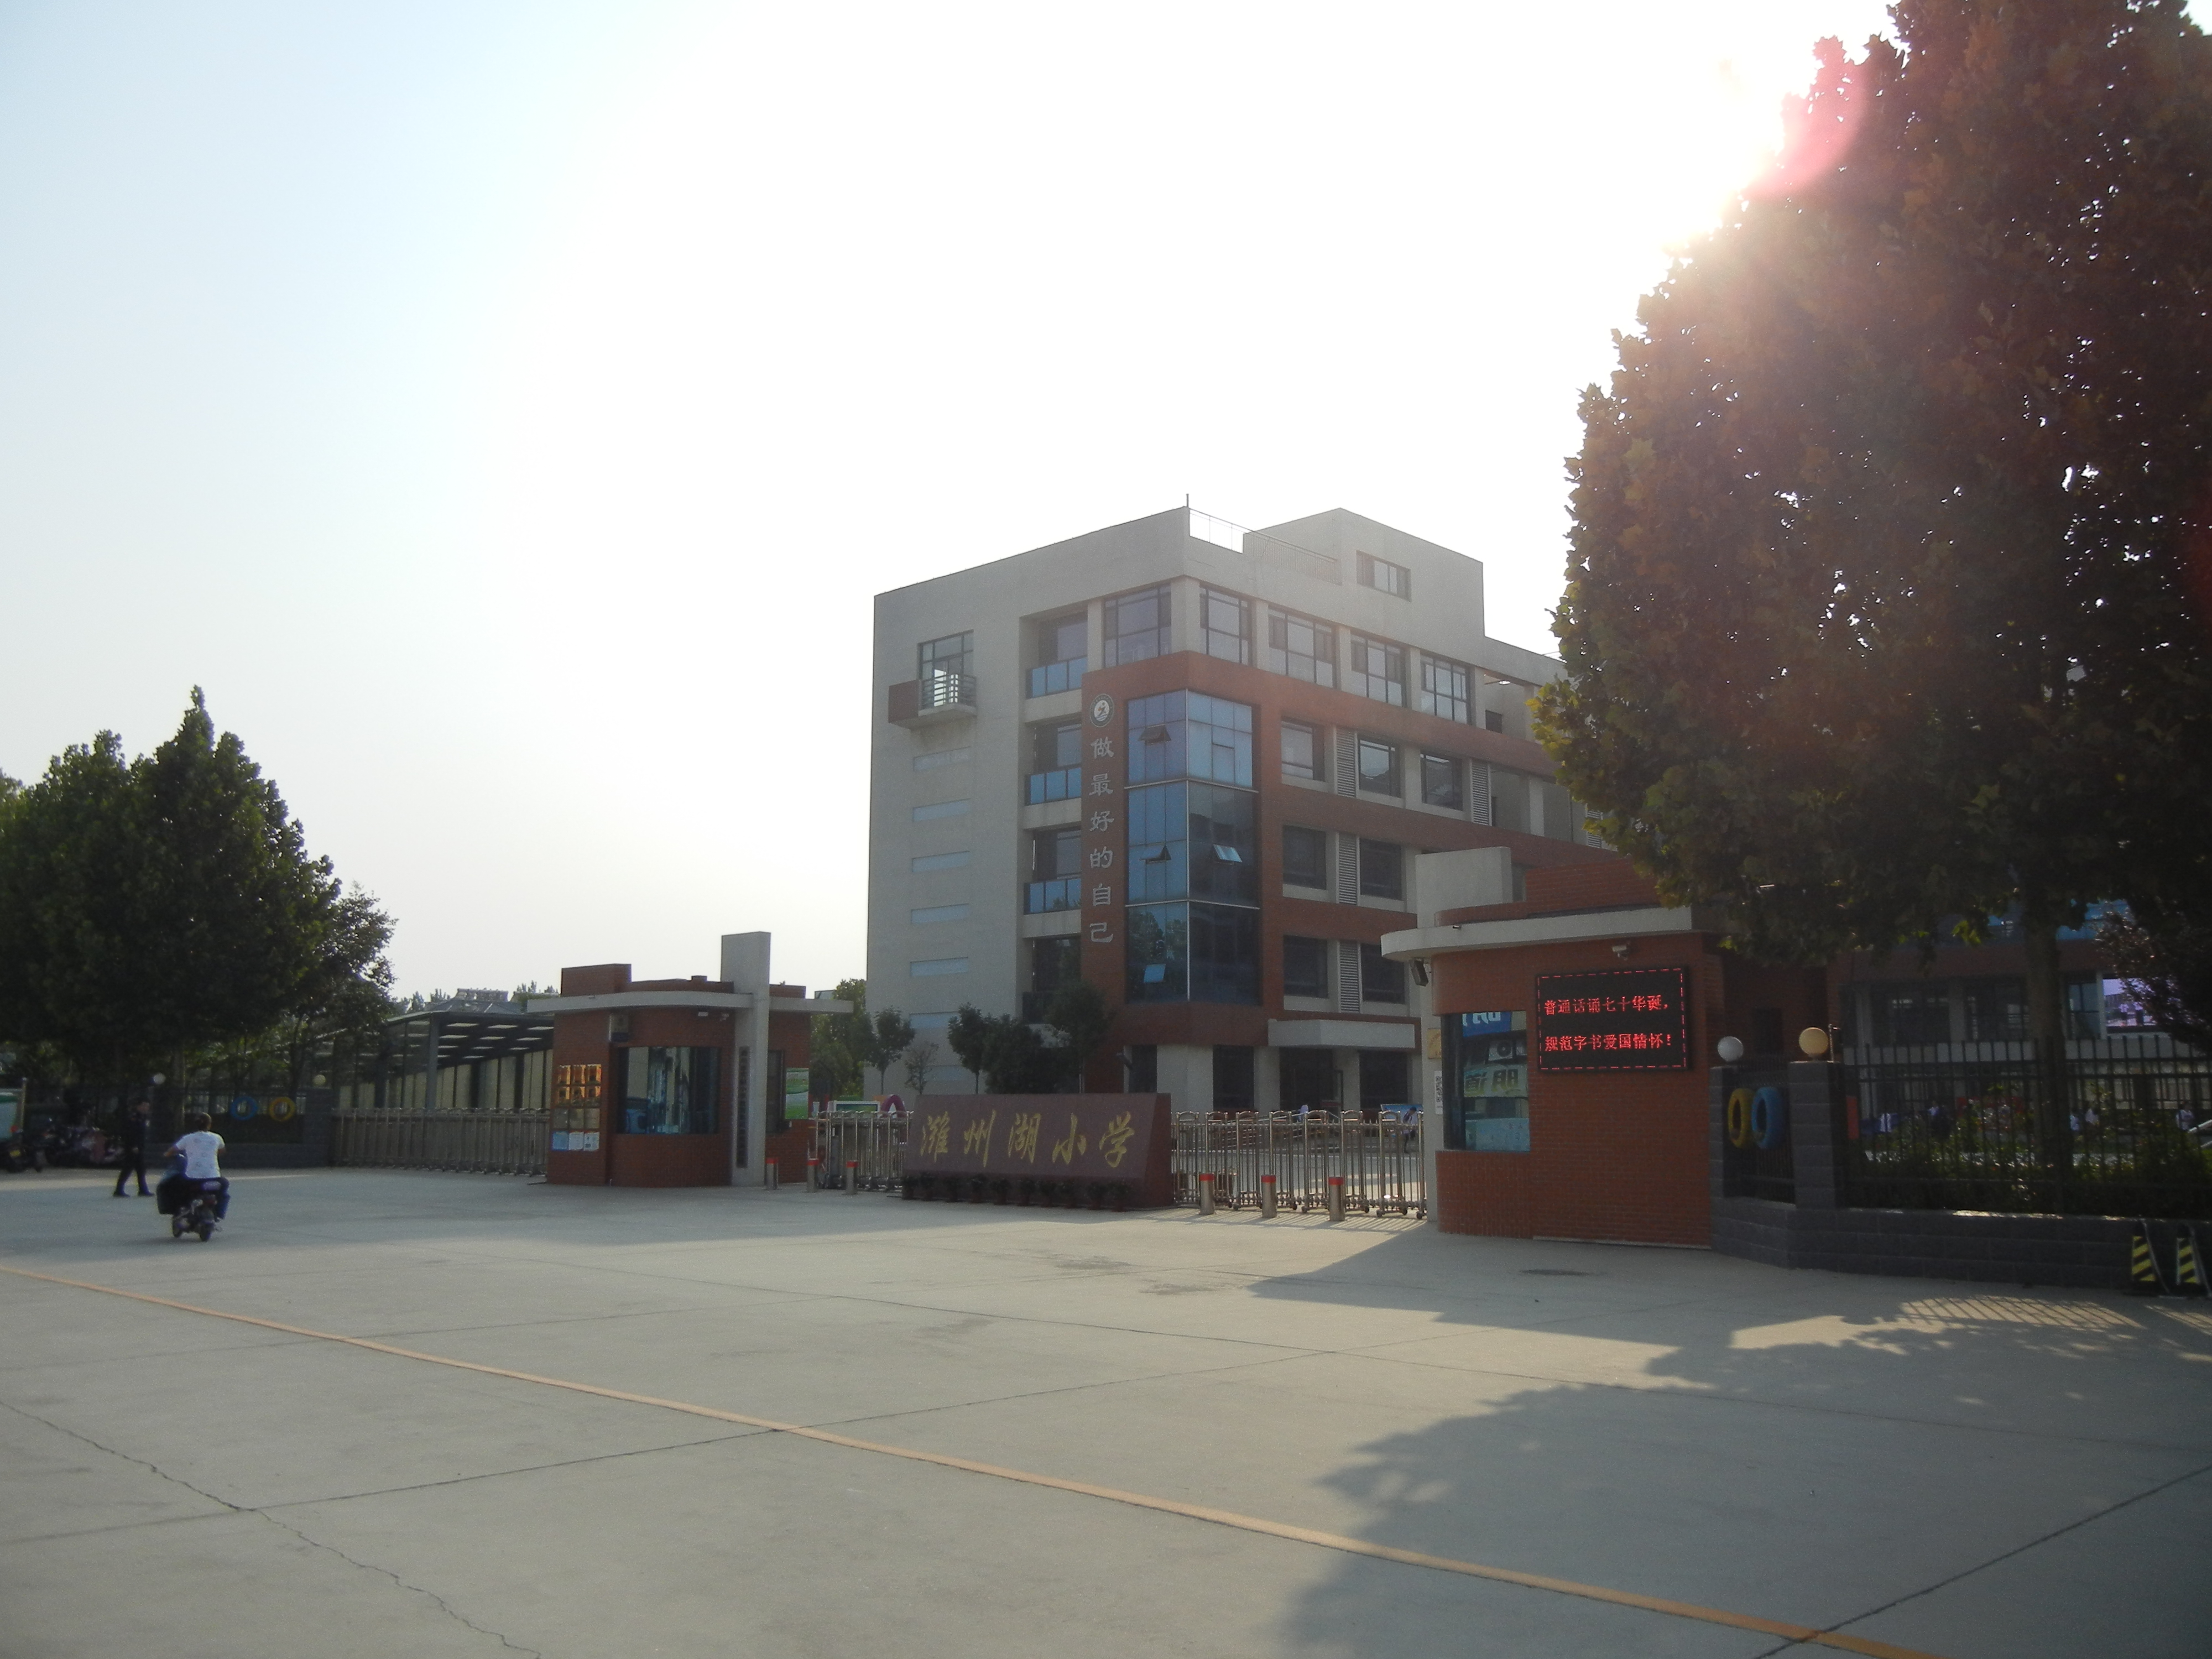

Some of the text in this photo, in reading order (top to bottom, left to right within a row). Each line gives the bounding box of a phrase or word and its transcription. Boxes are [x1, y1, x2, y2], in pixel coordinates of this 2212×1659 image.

[1089, 736, 1115, 943] 做最好的自己
